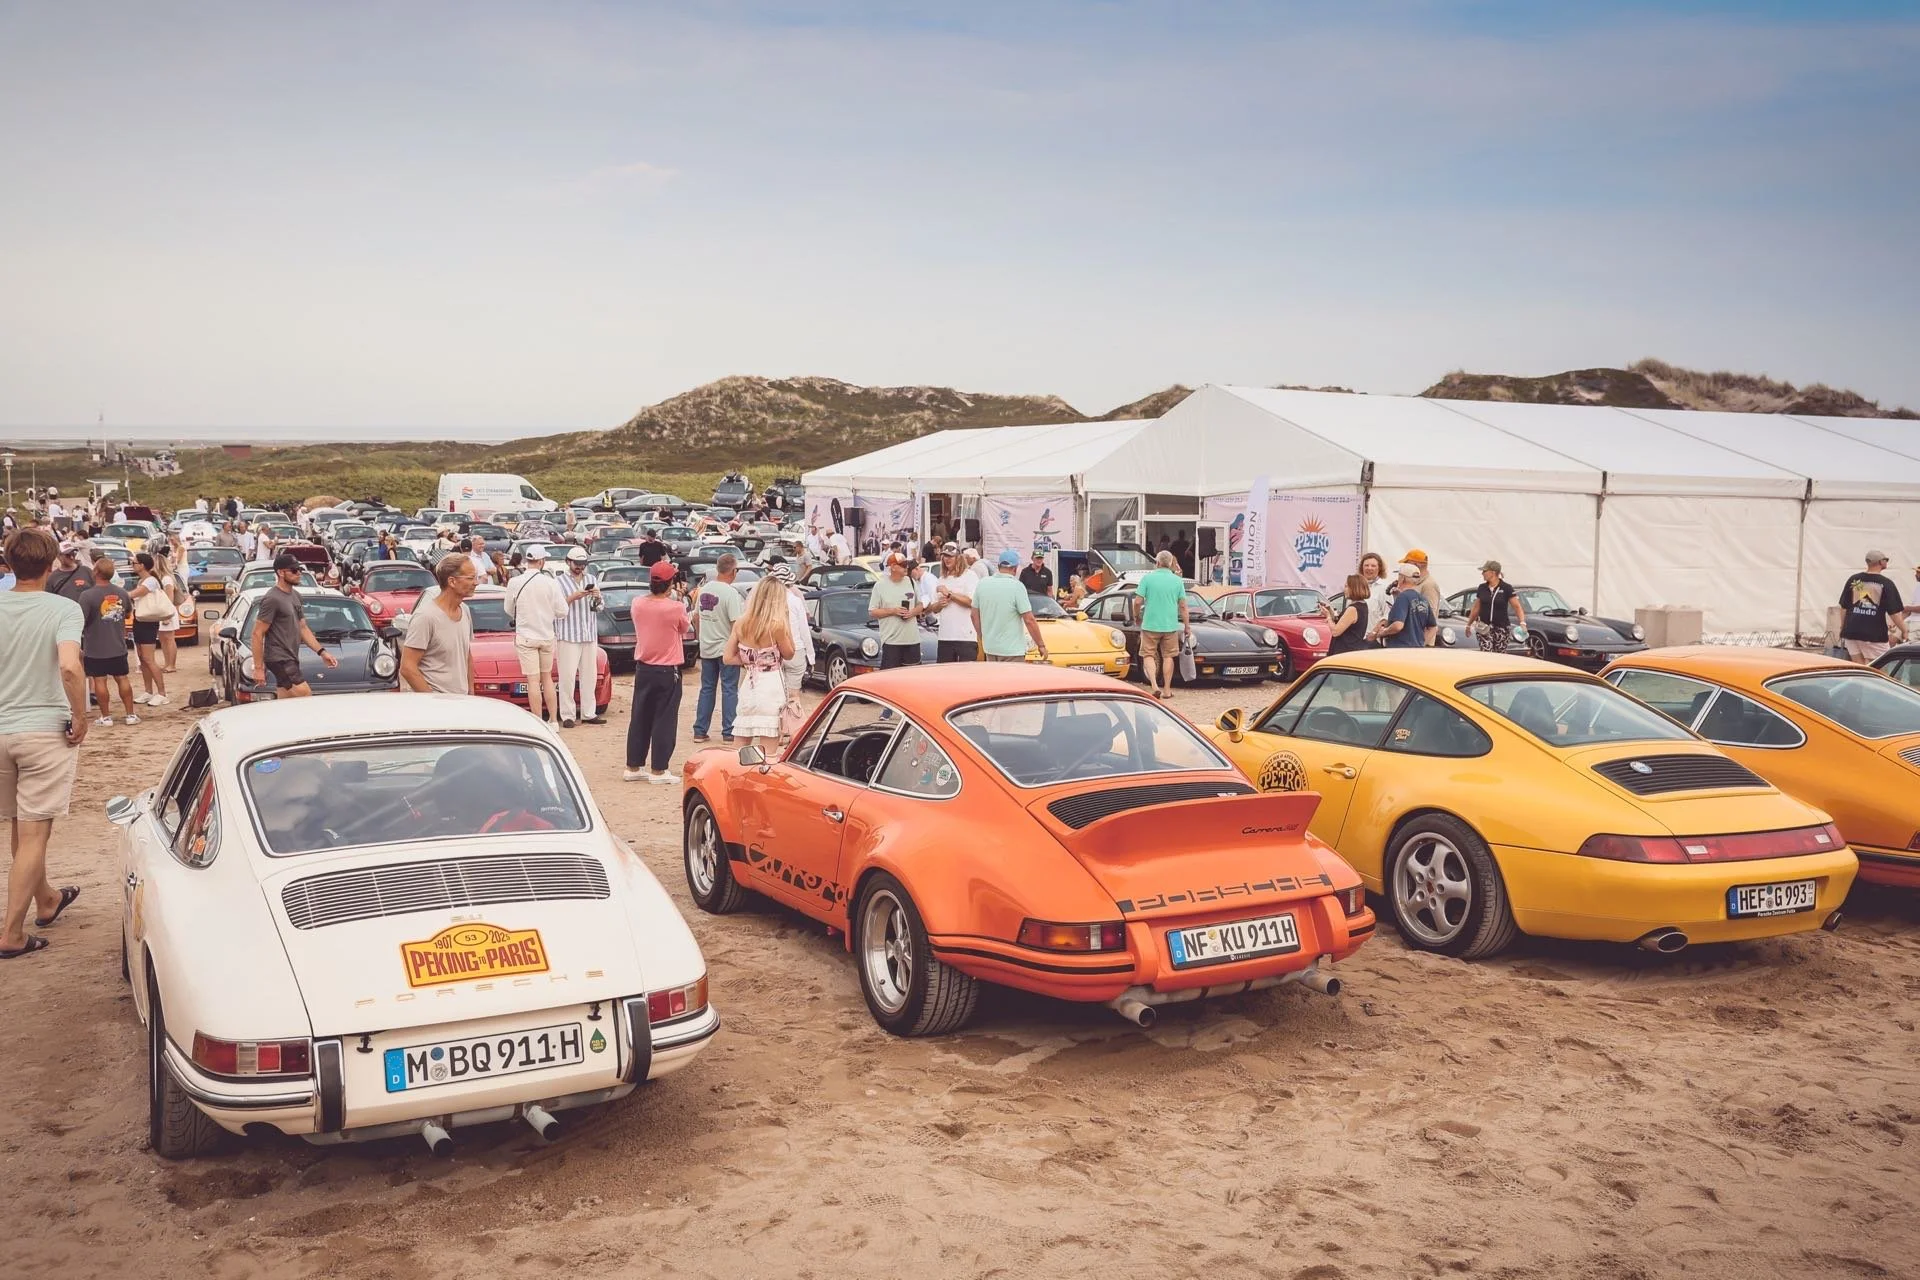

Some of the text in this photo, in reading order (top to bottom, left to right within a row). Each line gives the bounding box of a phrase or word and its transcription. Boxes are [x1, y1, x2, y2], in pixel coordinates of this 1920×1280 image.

[1247, 511, 1257, 569] UNION
[1296, 532, 1331, 551] PETRO
[1260, 770, 1302, 791] PETRO
[1242, 826, 1283, 834] Carrera
[745, 841, 849, 906] Carrera
[1740, 888, 1765, 911] HEF
[1774, 887, 1783, 907] G
[1785, 884, 1807, 906] 993
[434, 930, 511, 949] 1907 53 2025
[1183, 931, 1208, 958] NF
[1219, 925, 1246, 953] KU
[1249, 919, 1296, 947] 911H
[410, 937, 540, 979] PEKING TO PARIS
[393, 1029, 580, 1085] D M BQ 911H
